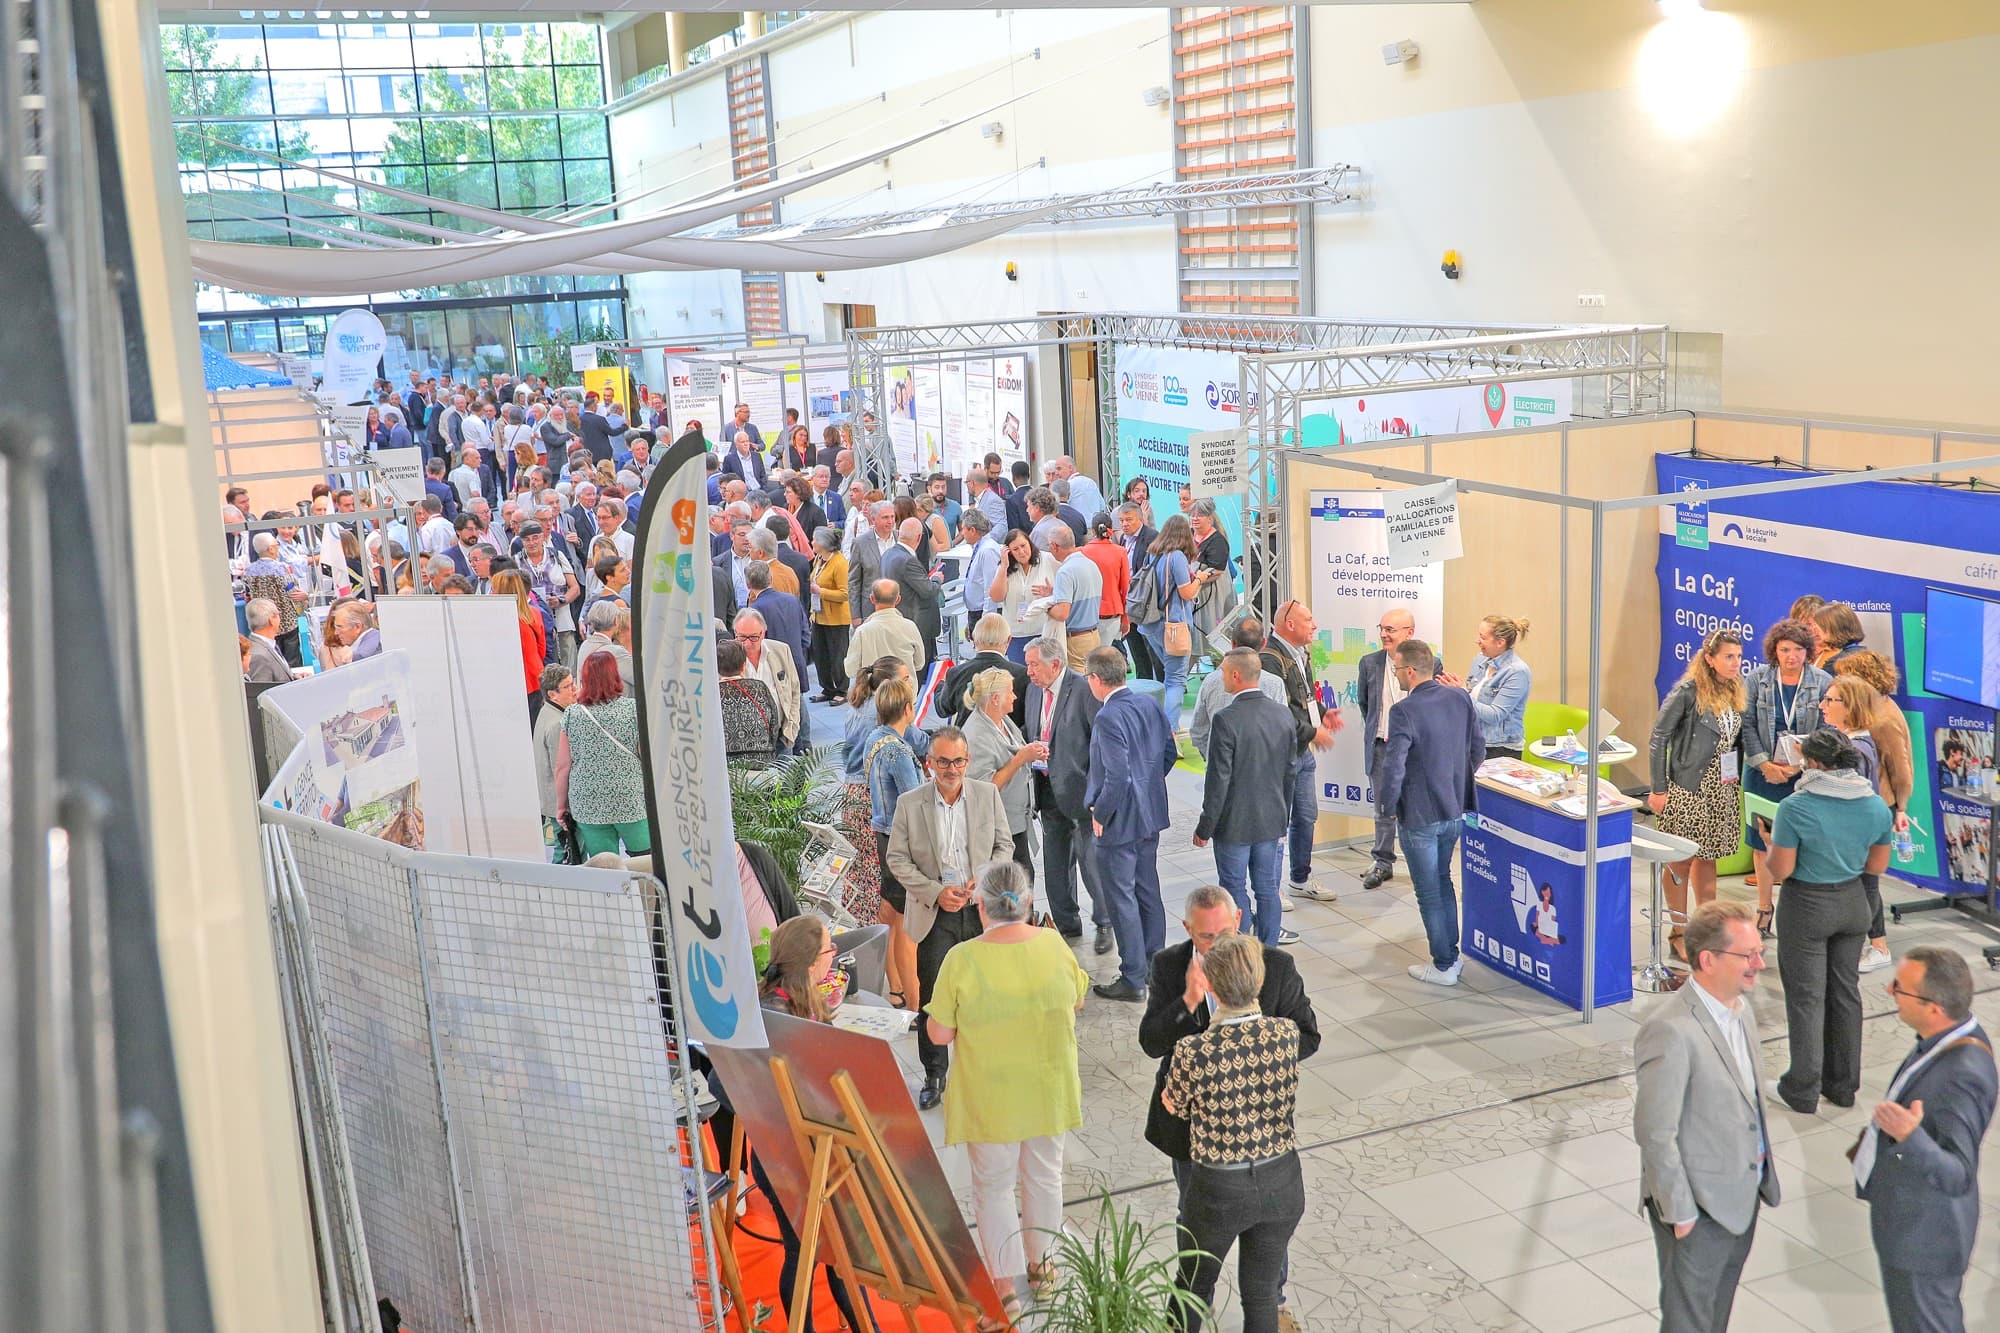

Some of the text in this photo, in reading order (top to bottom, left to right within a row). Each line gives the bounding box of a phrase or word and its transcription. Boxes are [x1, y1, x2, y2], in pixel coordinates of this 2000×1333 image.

[339, 334, 365, 344] eaux
[346, 342, 381, 353] Vienne
[1163, 375, 1180, 392] 100
[1201, 440, 1236, 450] SYNDICAT
[1138, 456, 1180, 473] TRANSITION
[1203, 459, 1229, 467] VIENNE
[1205, 467, 1234, 476] GROUPE
[1150, 476, 1172, 492] VOTRE
[1404, 496, 1436, 509] CAISSE
[1386, 504, 1456, 524] D'ALLOCATIONS
[1390, 515, 1455, 534] FAMILIALES DE
[1401, 528, 1446, 543] LA VIENNE
[1746, 534, 1767, 543] sociale
[1752, 527, 1778, 538] sécurité
[1327, 553, 1342, 564] La
[1345, 553, 1369, 566] Caf,
[1332, 569, 1424, 584] développement
[1337, 585, 1419, 600] des territoires
[1675, 567, 1739, 607] La Caf,
[1857, 600, 1892, 612] enfance
[1675, 608, 1754, 641] engagée
[1674, 642, 1692, 662] et
[1948, 716, 1985, 729] Enfance
[1939, 800, 1992, 817] Vie sociale
[1466, 836, 1487, 855] La Caf,
[1466, 850, 1491, 867] engagée
[1466, 862, 1498, 883] et solidaire
